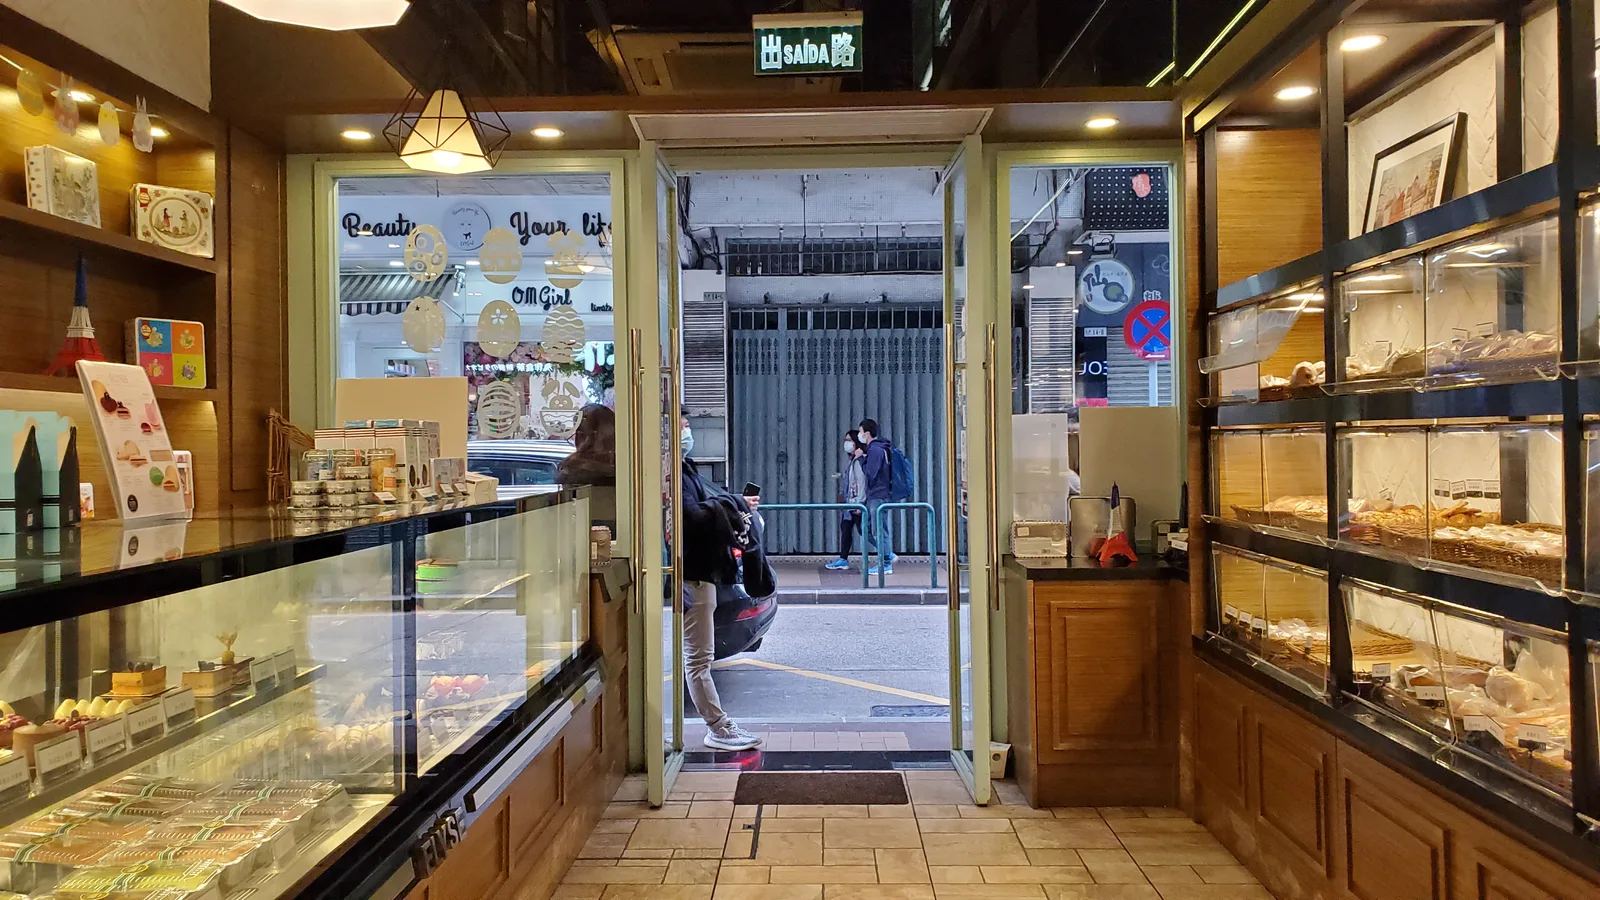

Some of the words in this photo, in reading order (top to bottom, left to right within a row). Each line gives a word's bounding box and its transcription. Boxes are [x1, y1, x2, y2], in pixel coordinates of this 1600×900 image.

[761, 34, 782, 69] 出
[783, 38, 829, 64] SAÍDA
[831, 31, 856, 67] 路
[511, 211, 570, 246] Your
